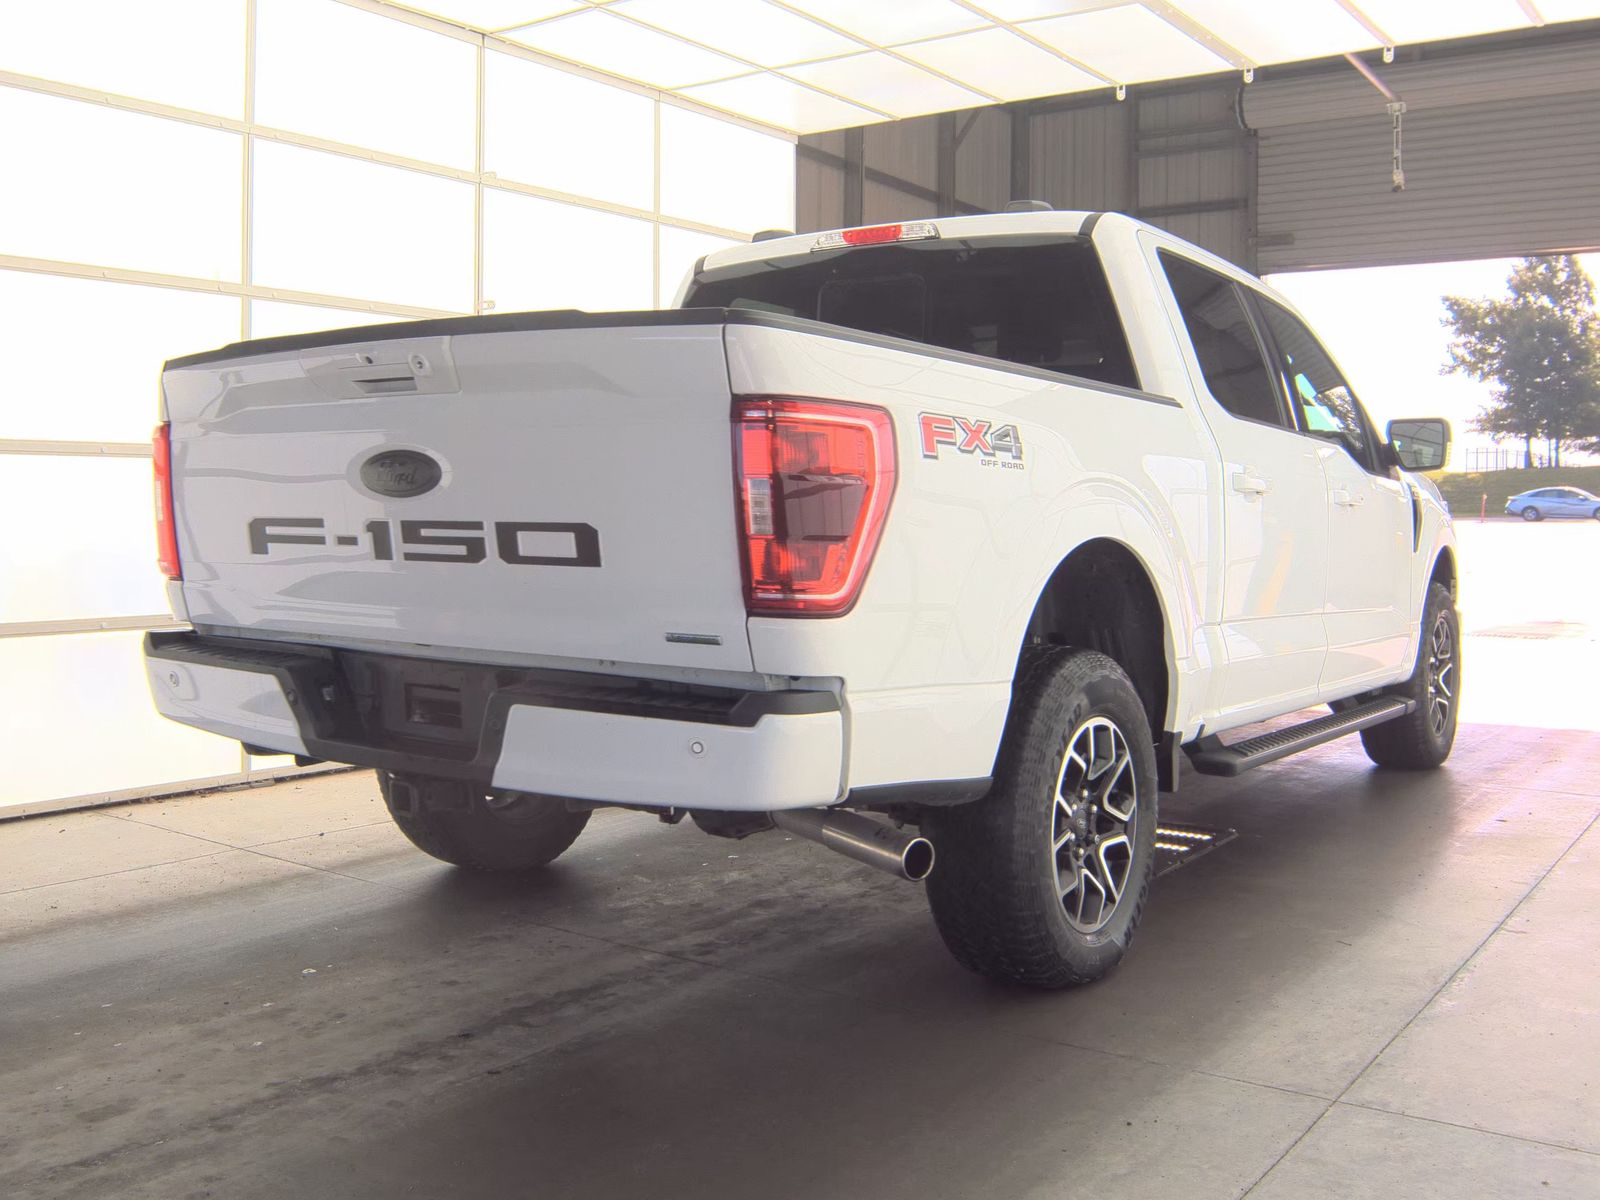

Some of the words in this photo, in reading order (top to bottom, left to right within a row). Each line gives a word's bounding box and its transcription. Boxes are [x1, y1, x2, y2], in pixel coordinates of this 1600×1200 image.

[918, 411, 1024, 460] FX4
[373, 457, 418, 488] Ford
[981, 458, 999, 468] OFF
[1001, 461, 1025, 470] ROAD
[248, 517, 602, 567] F-150
